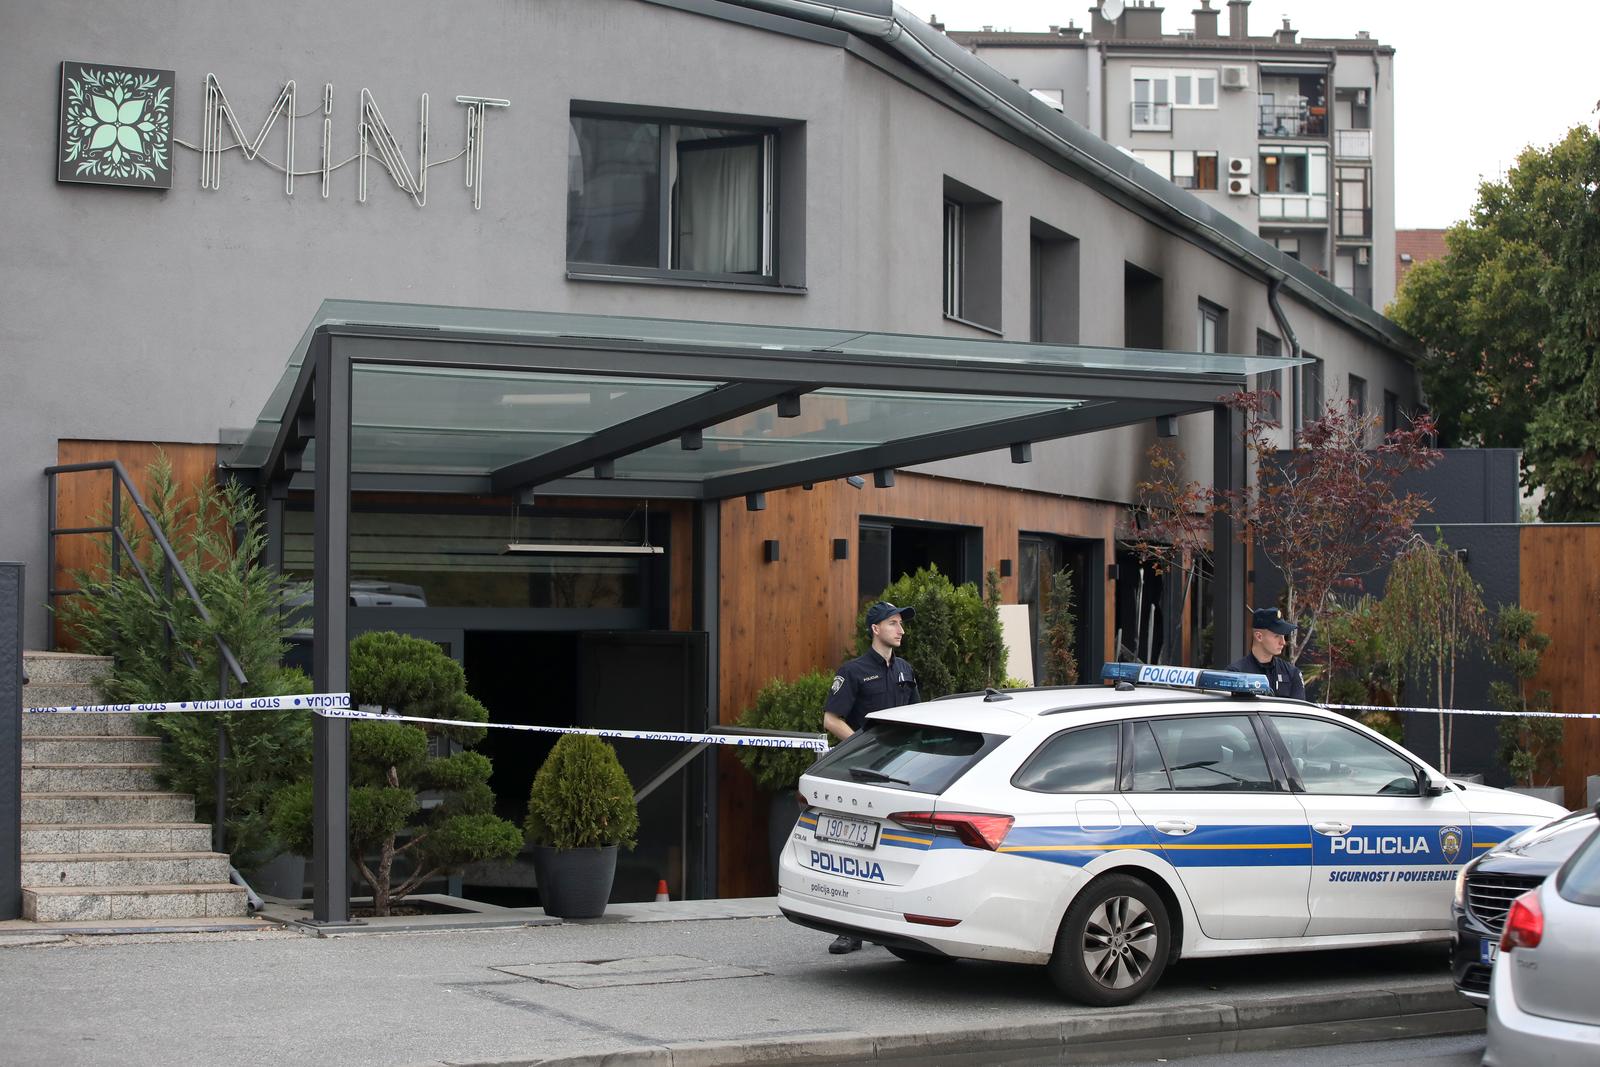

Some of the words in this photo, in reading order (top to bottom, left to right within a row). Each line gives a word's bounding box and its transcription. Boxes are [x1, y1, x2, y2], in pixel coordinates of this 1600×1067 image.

[1142, 667, 1195, 686] POLICIJA
[250, 698, 281, 709] STOP
[306, 695, 350, 707] OLICIJA
[825, 819, 843, 838] 190
[848, 823, 868, 843] 713
[1330, 836, 1430, 855] POLICIJA
[810, 850, 885, 881] POLICIJA
[1328, 870, 1389, 882] SIGURNOST
[1390, 871, 1396, 881] I
[810, 883, 849, 898] policija.gov.hr
